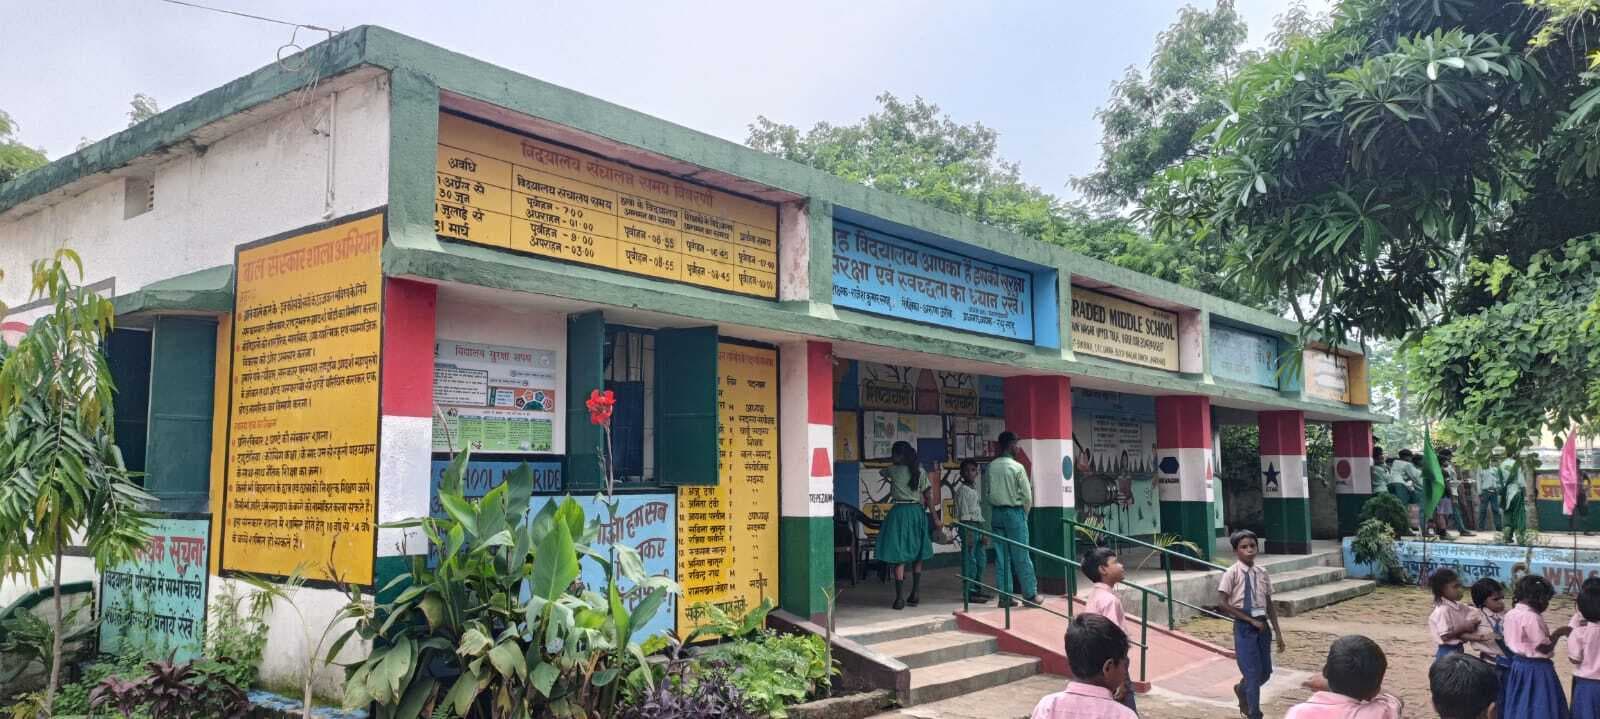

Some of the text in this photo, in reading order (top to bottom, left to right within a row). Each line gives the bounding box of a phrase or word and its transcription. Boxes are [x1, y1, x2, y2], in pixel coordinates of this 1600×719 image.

[447, 153, 476, 173] अवधि
[439, 188, 469, 204] 30 जून
[448, 218, 468, 236] मार्च
[242, 227, 379, 282] बाल संस्कार शाला अभियान
[919, 251, 960, 279] आपका
[875, 260, 893, 287] एवं
[950, 283, 965, 303] का
[1072, 299, 1174, 341] RADED MIDDLE SCHOOL
[438, 468, 492, 489] SHOOL
[532, 468, 560, 490] RIDE
[625, 506, 643, 538] हम
[645, 502, 668, 524] सब
[157, 570, 165, 595] में
